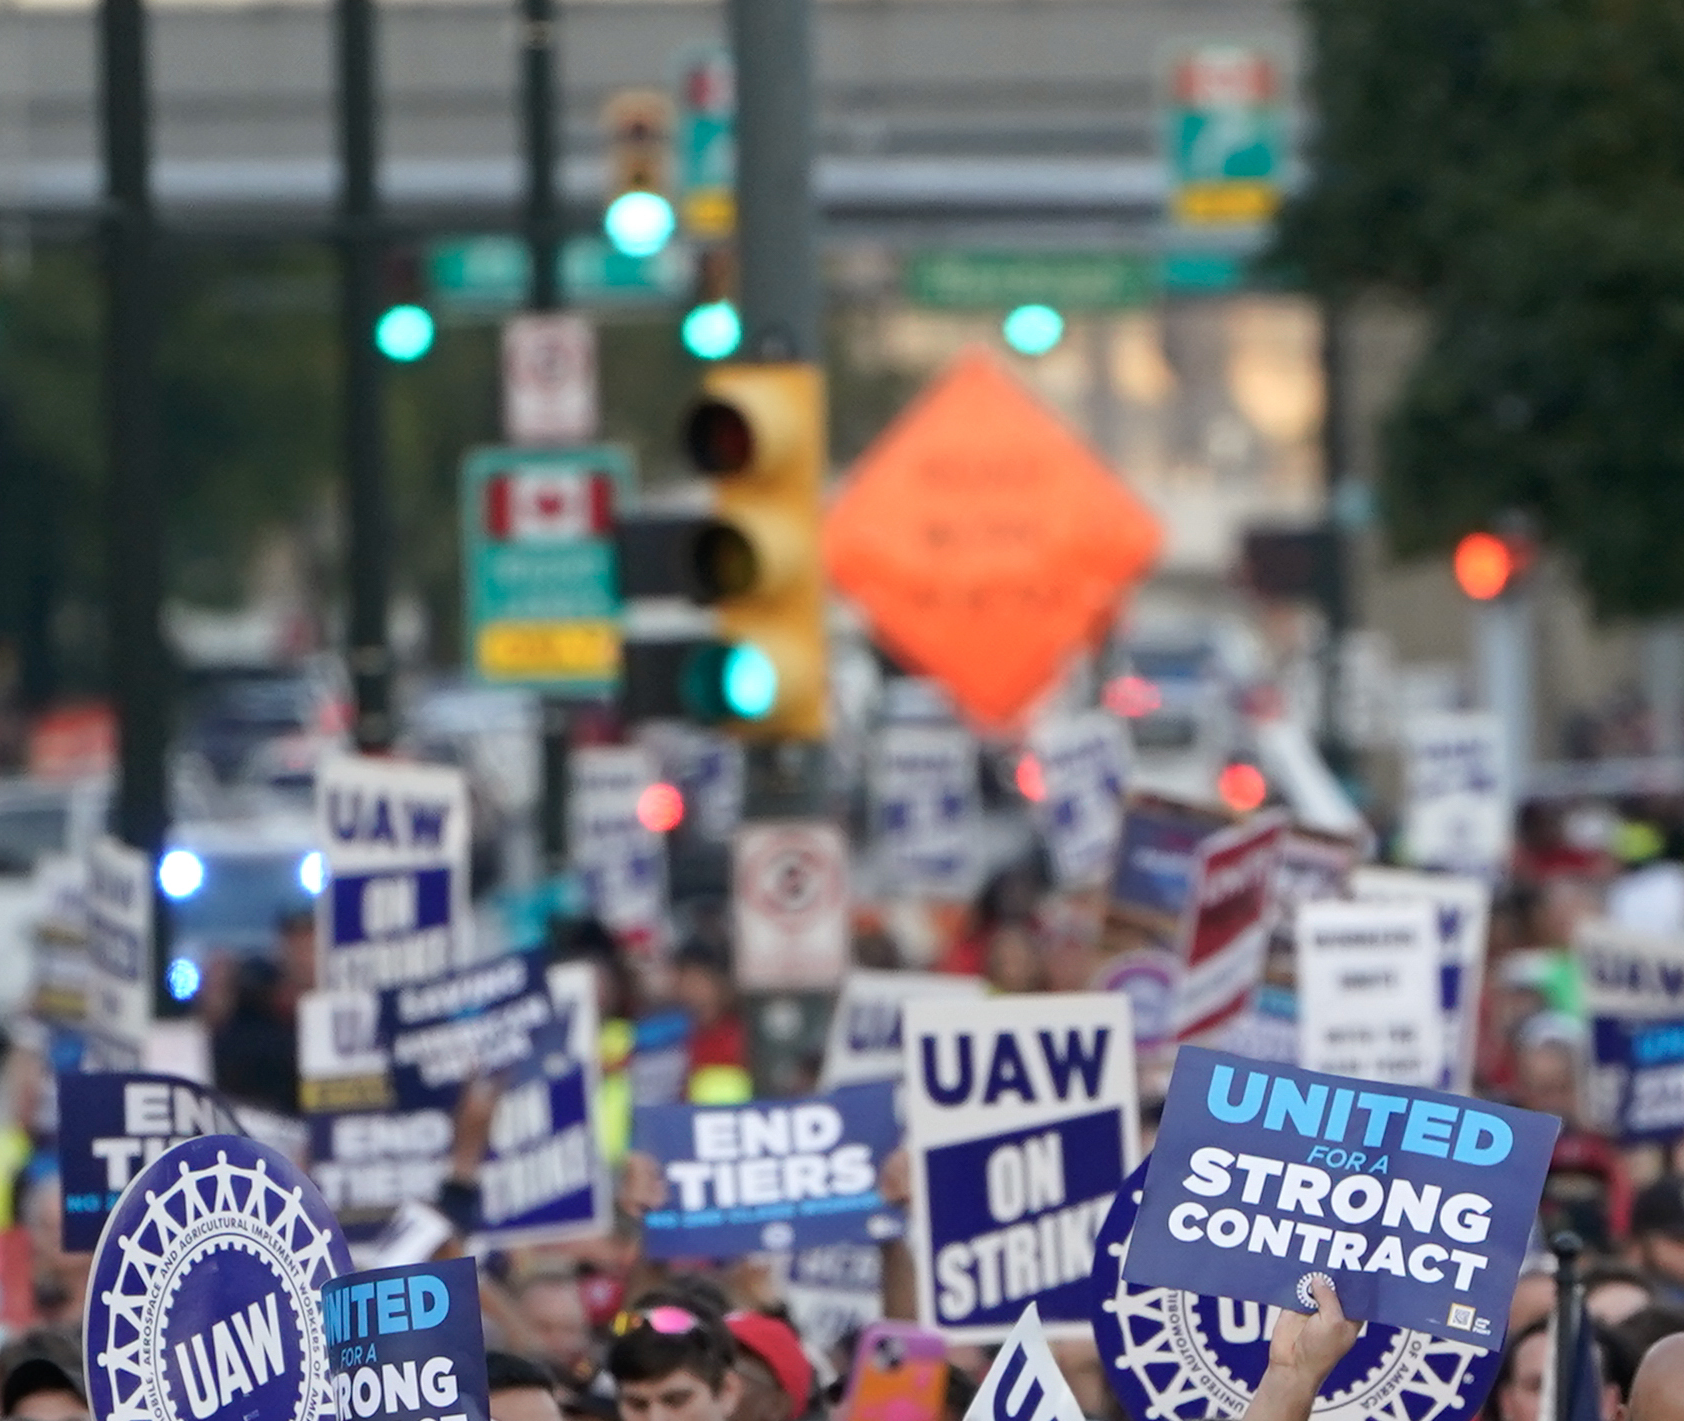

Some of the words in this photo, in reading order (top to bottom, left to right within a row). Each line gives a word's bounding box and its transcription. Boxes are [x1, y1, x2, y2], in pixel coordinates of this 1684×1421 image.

[325, 789, 452, 848] UAW
[920, 1025, 1111, 1108] UAW
[692, 1103, 844, 1161] END
[1206, 1064, 1514, 1167] UNITED
[666, 1143, 877, 1212] TIERS
[985, 1130, 1065, 1225] ON
[1182, 1146, 1493, 1244] STRONG
[1307, 1144, 1365, 1174] FOR
[1368, 1154, 1389, 1175] A
[936, 1191, 1116, 1322] STRIK
[1168, 1201, 1488, 1292] CONTRACT
[143, 1282, 161, 1366] AEROSPACE
[159, 1250, 179, 1280] AND
[178, 1216, 249, 1253] AGRICULTURAL
[251, 1223, 301, 1279] IMPLEMENT
[299, 1281, 320, 1354] WORKERS
[312, 1360, 322, 1381] OF
[326, 1274, 451, 1346] NITED
[1166, 1289, 1200, 1373] AUTOMOBIL
[174, 1291, 286, 1421] UAW
[341, 1348, 363, 1368] FOR
[365, 1342, 378, 1363] A
[1360, 1362, 1411, 1411] AMERICA
[1409, 1339, 1422, 1359] OF
[1199, 1374, 1245, 1413] UNITED
